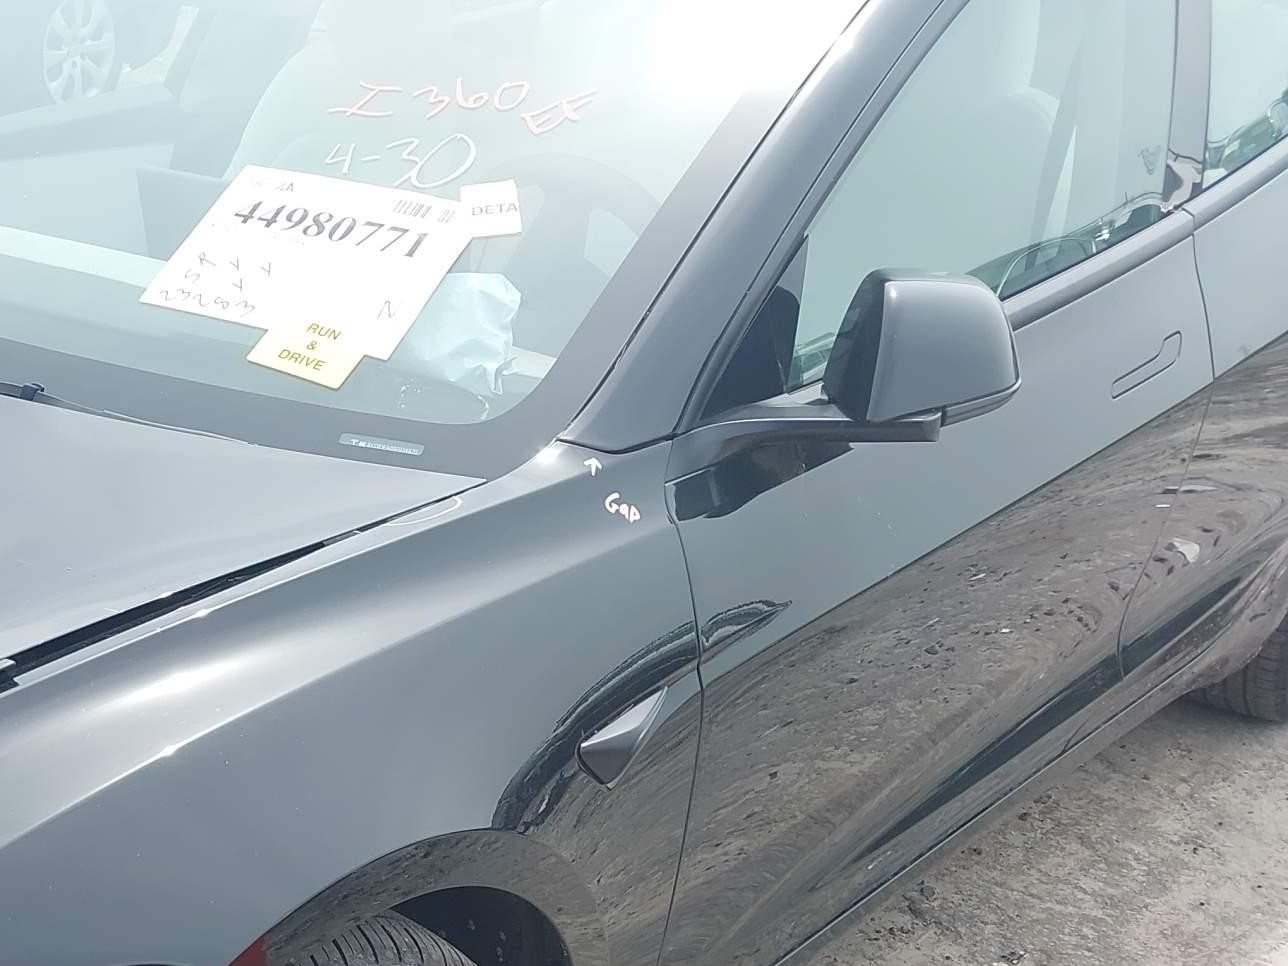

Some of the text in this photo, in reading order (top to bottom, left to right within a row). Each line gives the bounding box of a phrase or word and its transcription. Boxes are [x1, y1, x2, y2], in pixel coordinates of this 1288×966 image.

[325, 133, 478, 189] 4-30
[234, 199, 431, 259] 44980771
[305, 322, 342, 341] RUN
[305, 340, 319, 352] &
[277, 349, 327, 373] DRIVE
